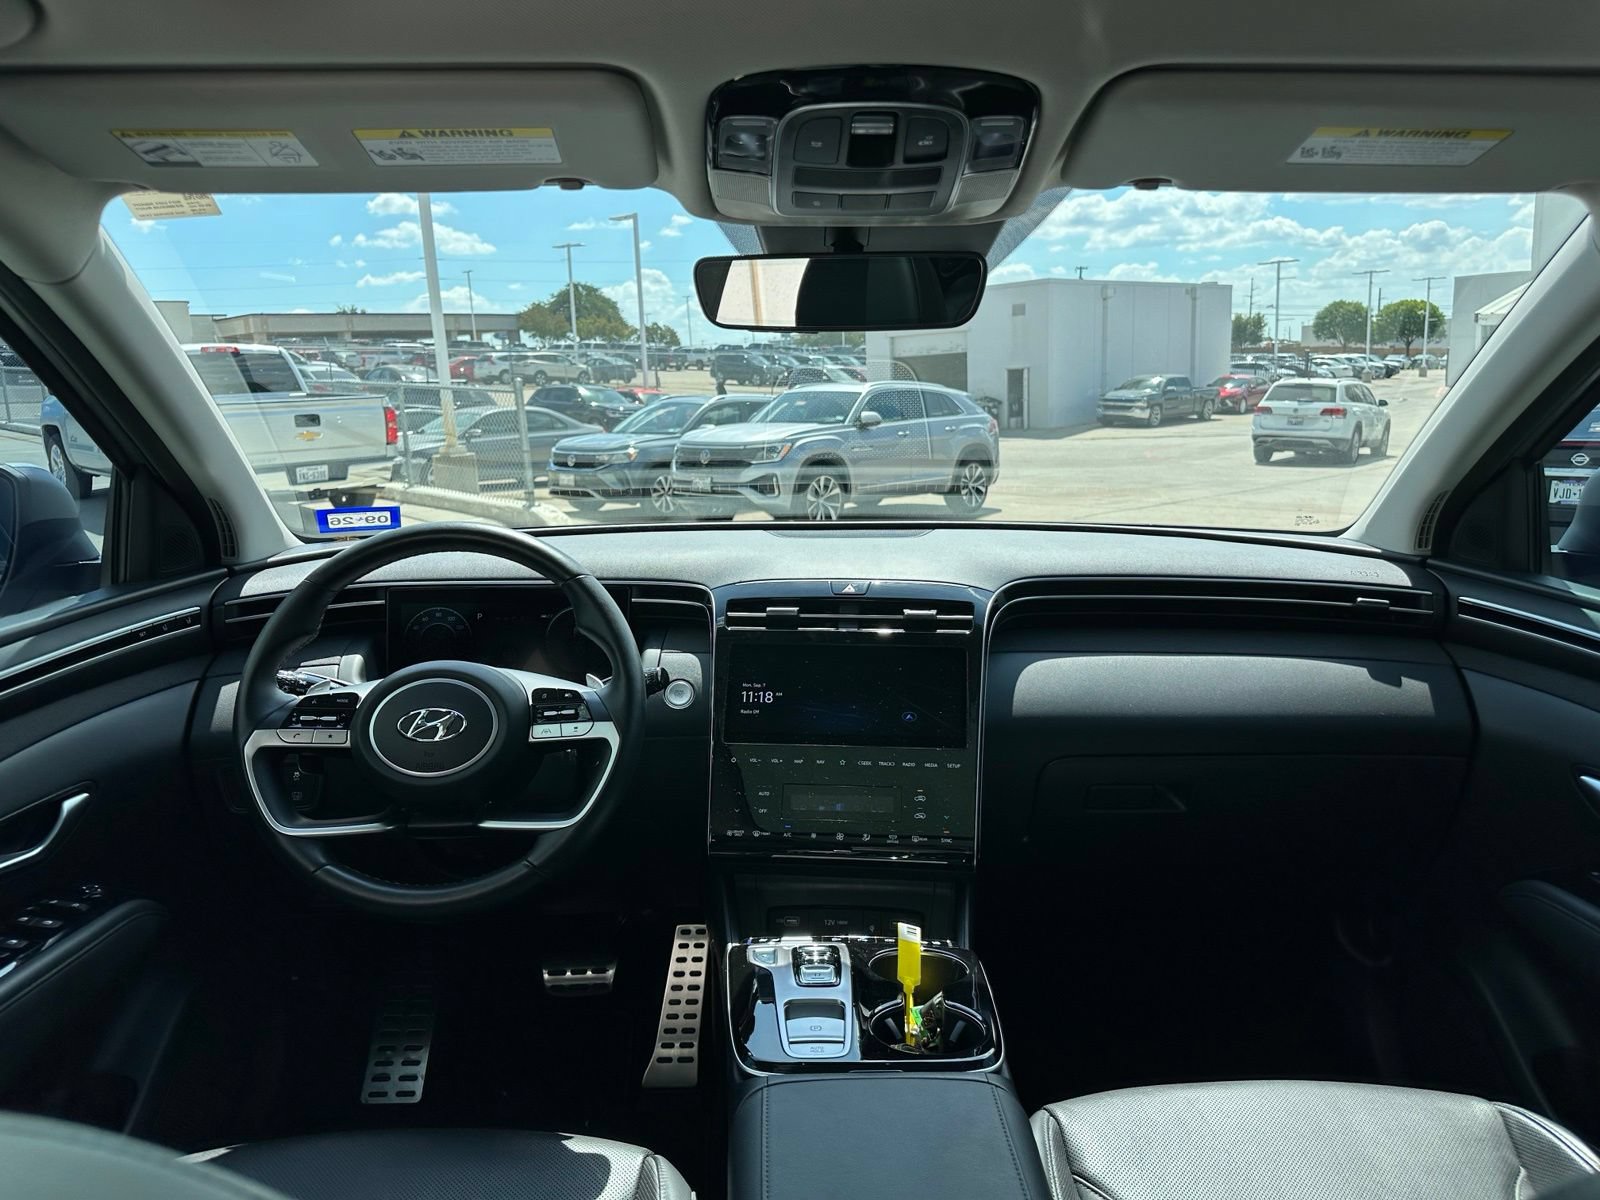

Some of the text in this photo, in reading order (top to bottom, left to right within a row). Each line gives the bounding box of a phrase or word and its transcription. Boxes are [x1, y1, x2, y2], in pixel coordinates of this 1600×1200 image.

[418, 129, 513, 138] WARNING
[1376, 129, 1472, 139] WARNING
[477, 612, 483, 620] P
[741, 691, 773, 703] 11:18
